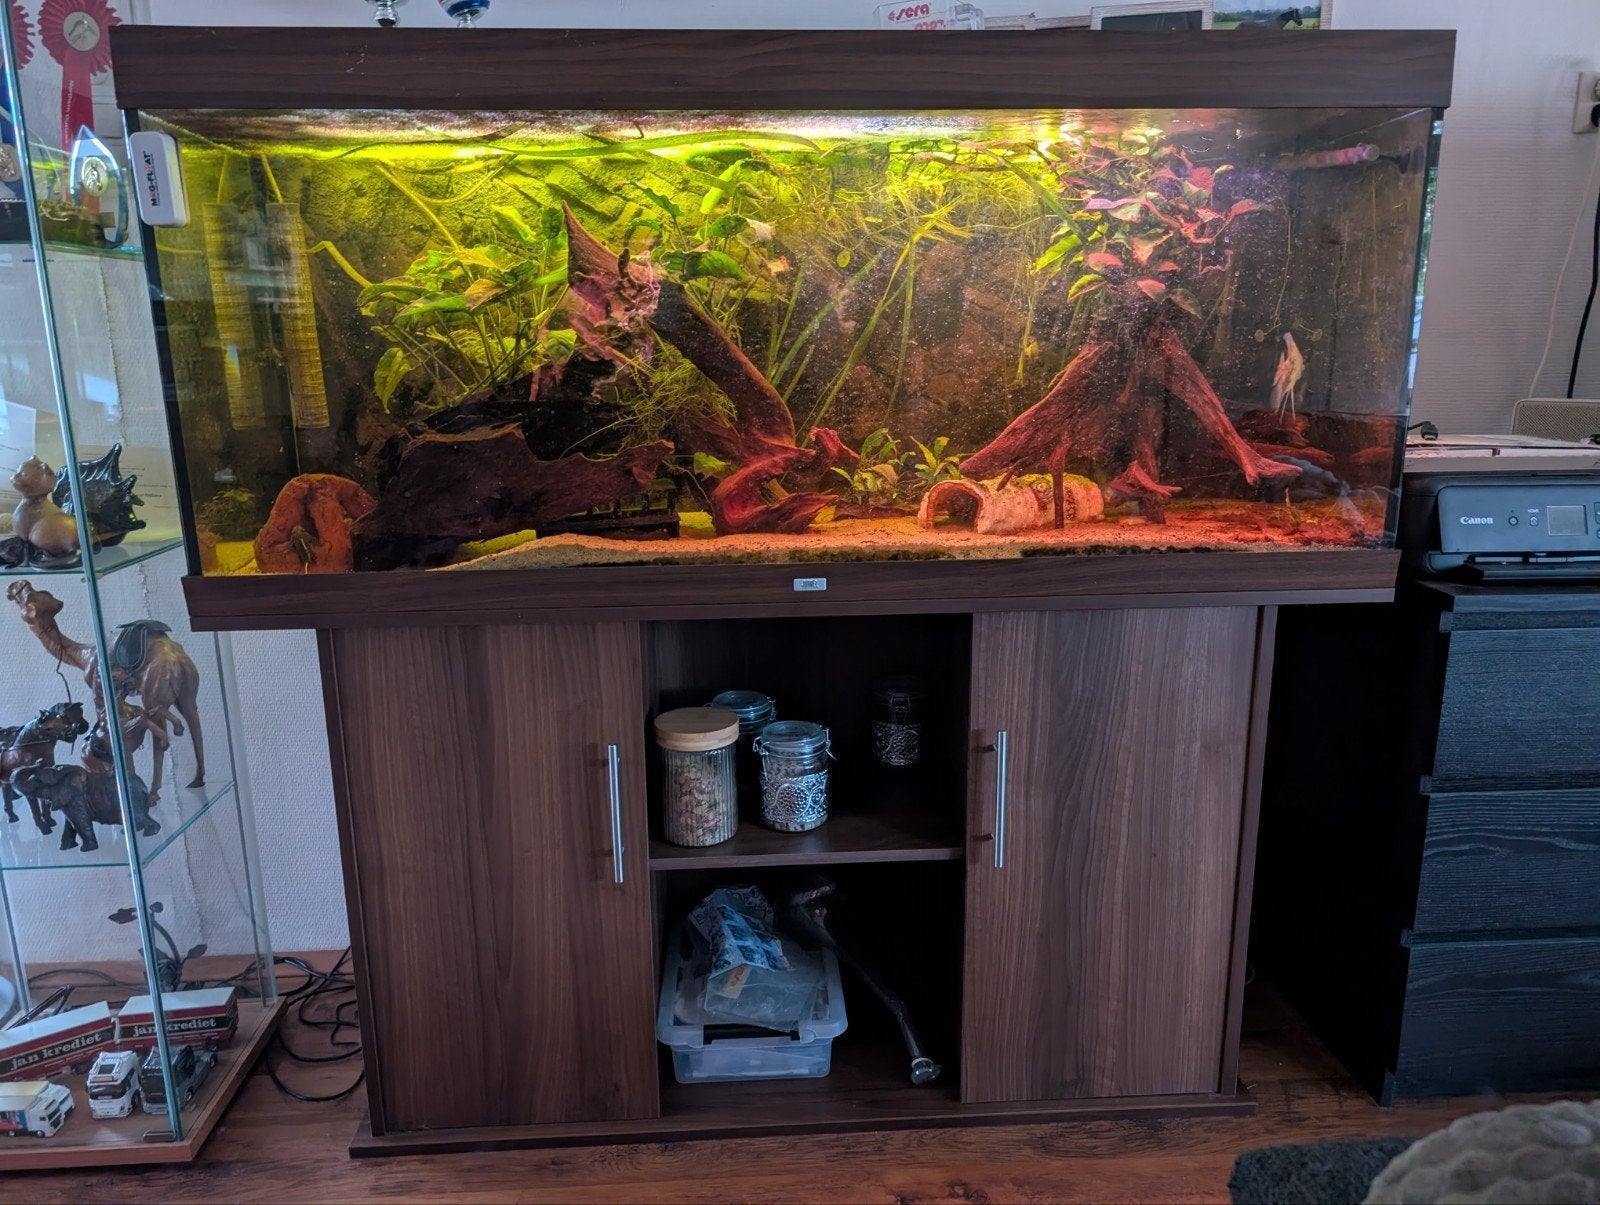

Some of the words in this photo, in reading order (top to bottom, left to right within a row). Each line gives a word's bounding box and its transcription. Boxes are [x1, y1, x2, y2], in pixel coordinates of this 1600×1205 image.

[896, 4, 930, 20] sera
[1460, 516, 1494, 525] Canon
[11, 1054, 40, 1071] jan
[42, 1033, 102, 1059] krediet
